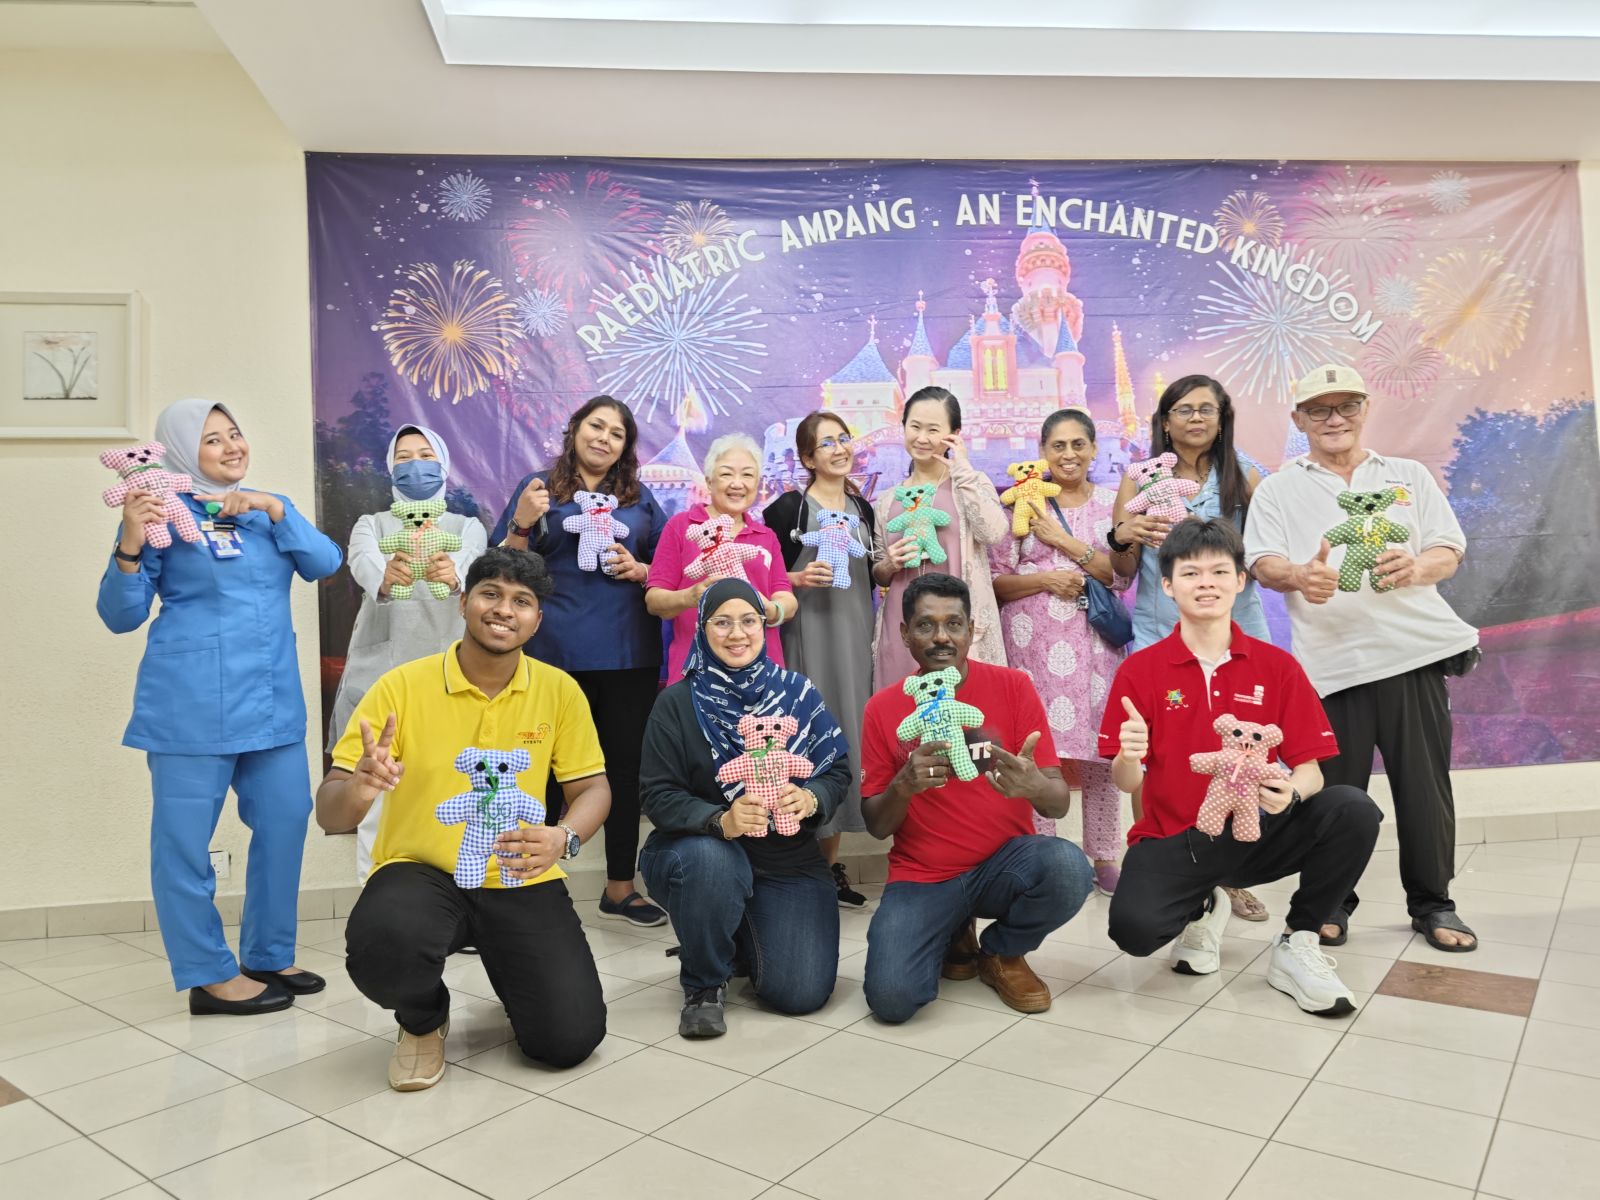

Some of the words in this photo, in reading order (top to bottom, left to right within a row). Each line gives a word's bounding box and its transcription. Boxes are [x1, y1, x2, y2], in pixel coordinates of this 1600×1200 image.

[576, 229, 766, 355] PAEDIATRIC
[780, 197, 917, 253] AMPANG
[956, 193, 1000, 226] AN
[1016, 194, 1220, 255] ENCHANTED
[1229, 235, 1383, 343] KINGDOM
